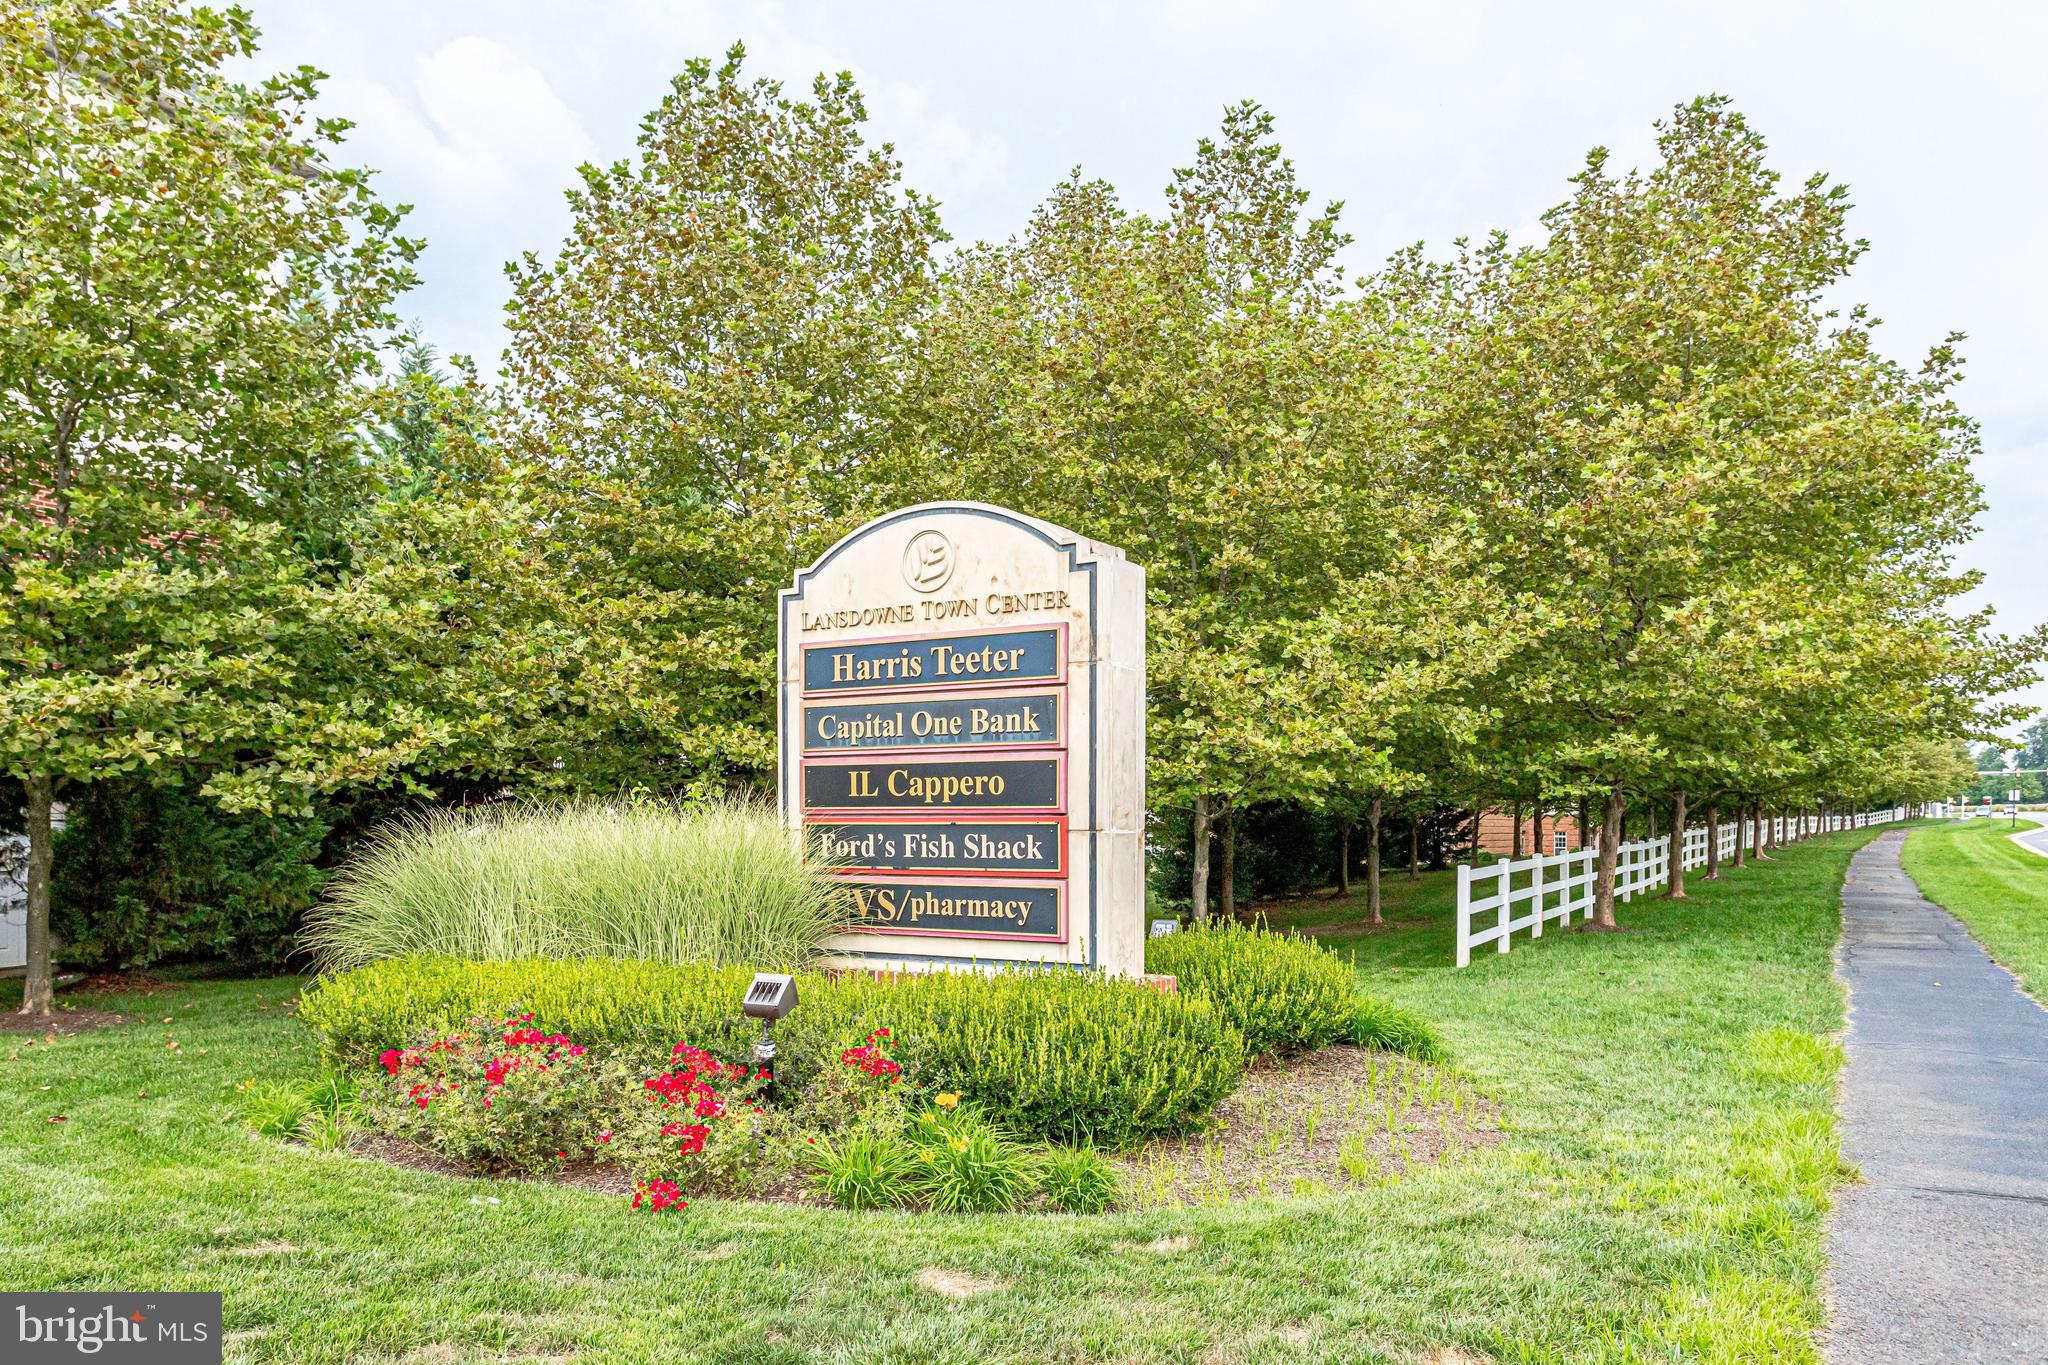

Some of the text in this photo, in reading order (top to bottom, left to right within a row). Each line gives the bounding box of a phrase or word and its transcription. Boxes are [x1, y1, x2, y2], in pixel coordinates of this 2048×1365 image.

[801, 590, 1070, 631] LANSDOWNE TOWN CENTER
[832, 646, 1025, 682] Harris Teeter
[818, 707, 1040, 746] Capital One Bank
[848, 769, 1005, 803] IL Cappero
[821, 834, 1043, 859] Ford's Fish Shack
